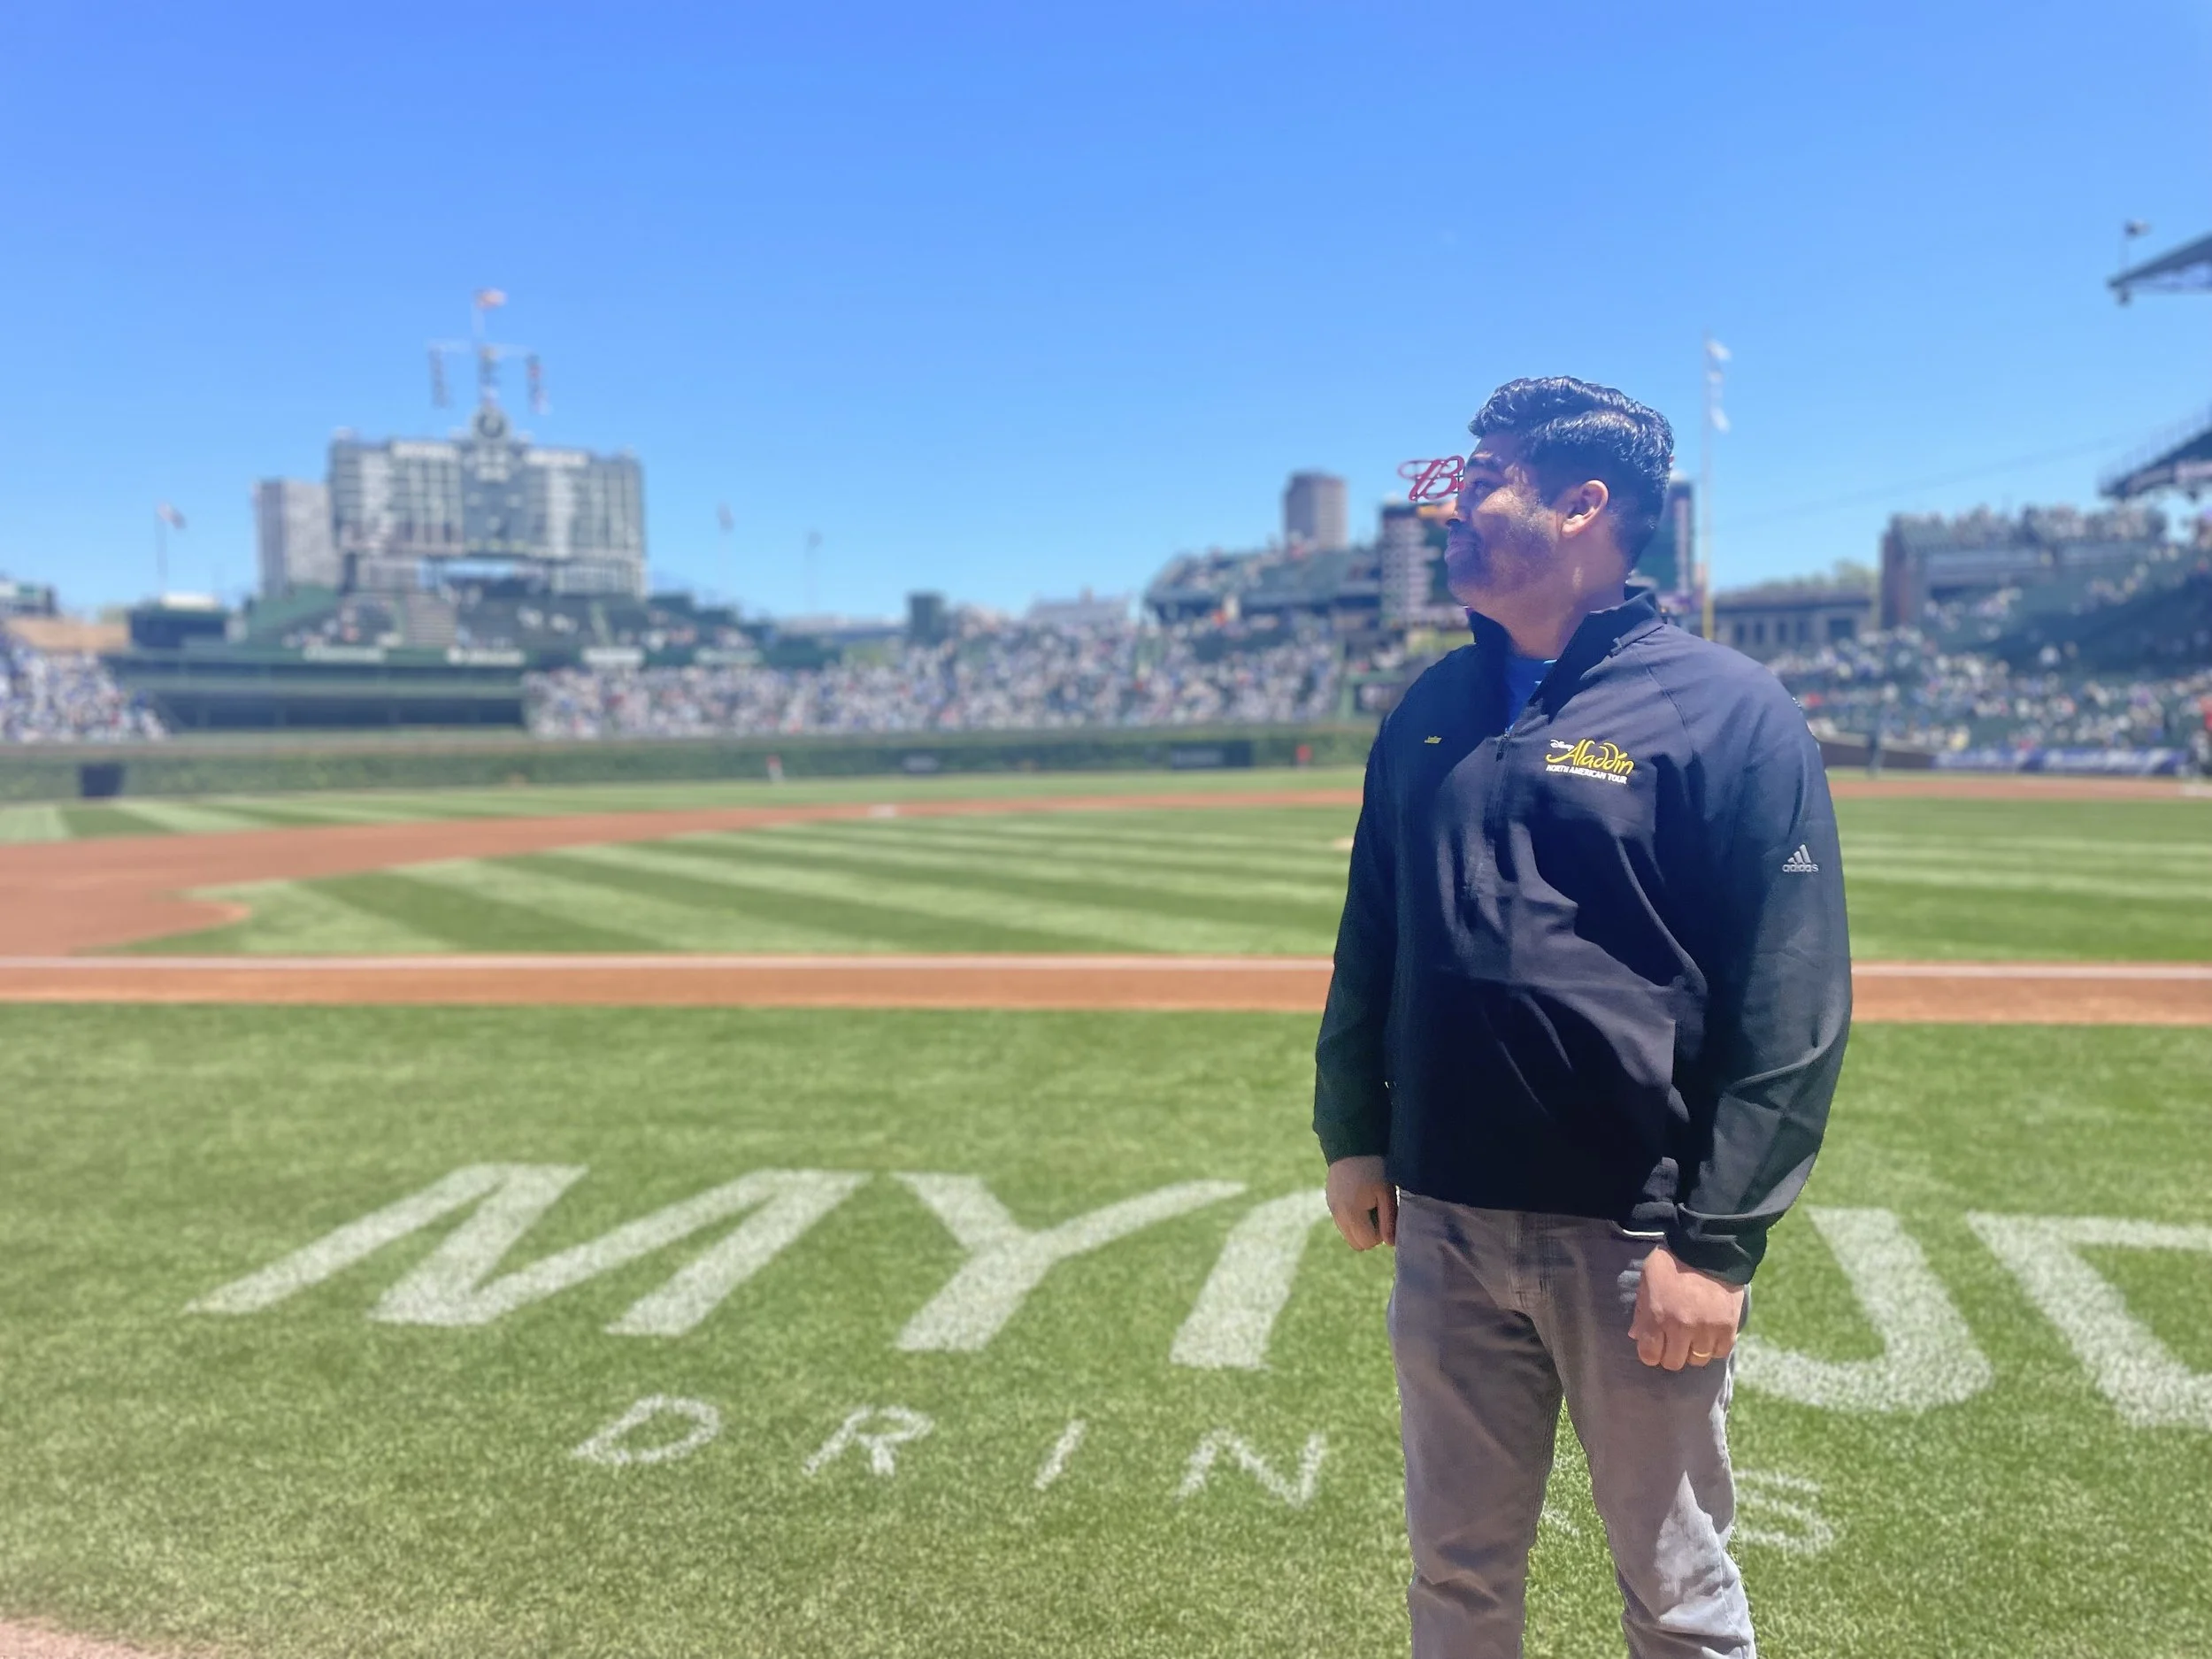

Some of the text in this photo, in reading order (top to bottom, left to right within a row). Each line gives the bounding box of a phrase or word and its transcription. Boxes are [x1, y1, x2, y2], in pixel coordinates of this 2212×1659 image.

[1546, 739, 1634, 775] Aladdin
[1546, 764, 1628, 784] NORTH AMERICAN TOUR
[1782, 864, 1819, 872] adidas
[568, 1394, 1836, 1555] DRINS
